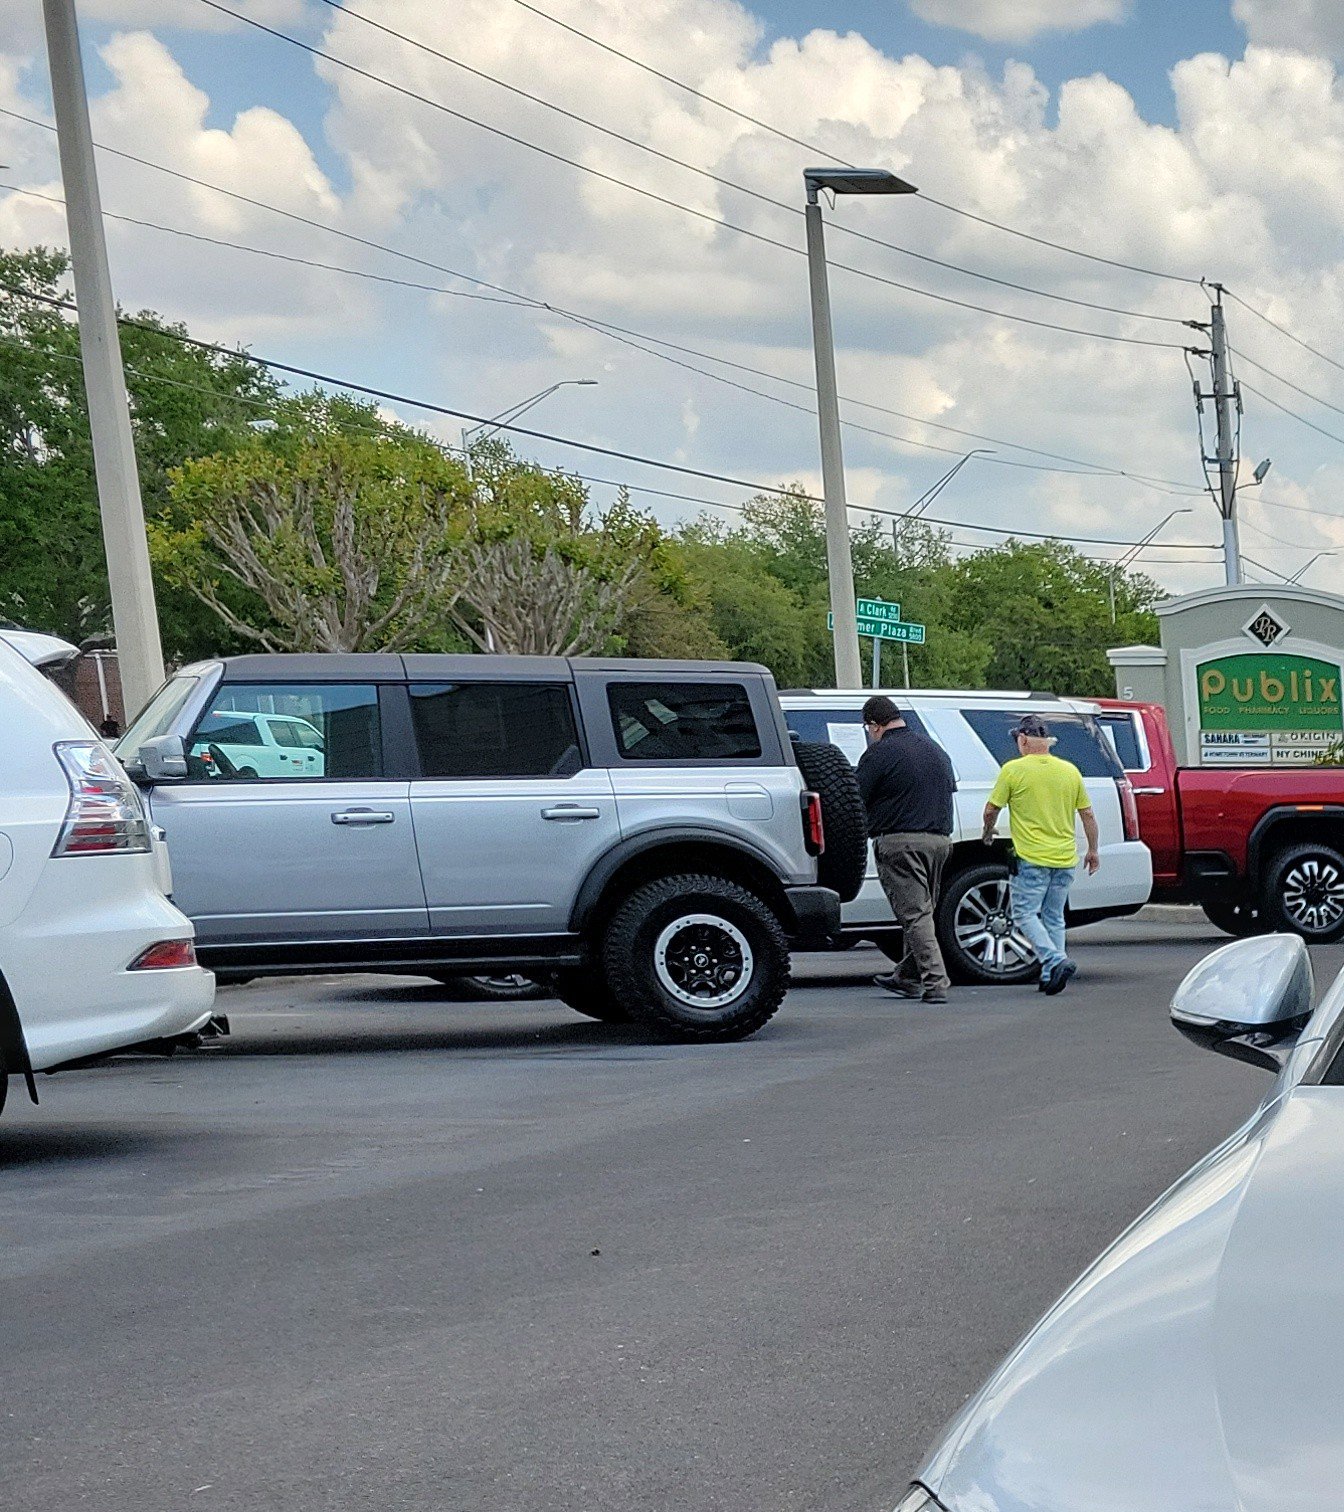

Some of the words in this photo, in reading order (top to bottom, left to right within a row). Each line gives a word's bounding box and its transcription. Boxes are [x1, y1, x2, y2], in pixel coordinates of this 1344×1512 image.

[867, 603, 886, 617] Clark
[880, 623, 907, 638] Plaza
[1202, 670, 1338, 703] Publix
[1123, 687, 1134, 700] 5
[1204, 706, 1230, 715] FOOD
[1238, 706, 1290, 715] PHARMACY
[1300, 706, 1339, 715] LIQUORS
[1204, 734, 1240, 744] SAHARA
[1290, 732, 1336, 741] ORIGIN
[1276, 750, 1290, 758] NY
